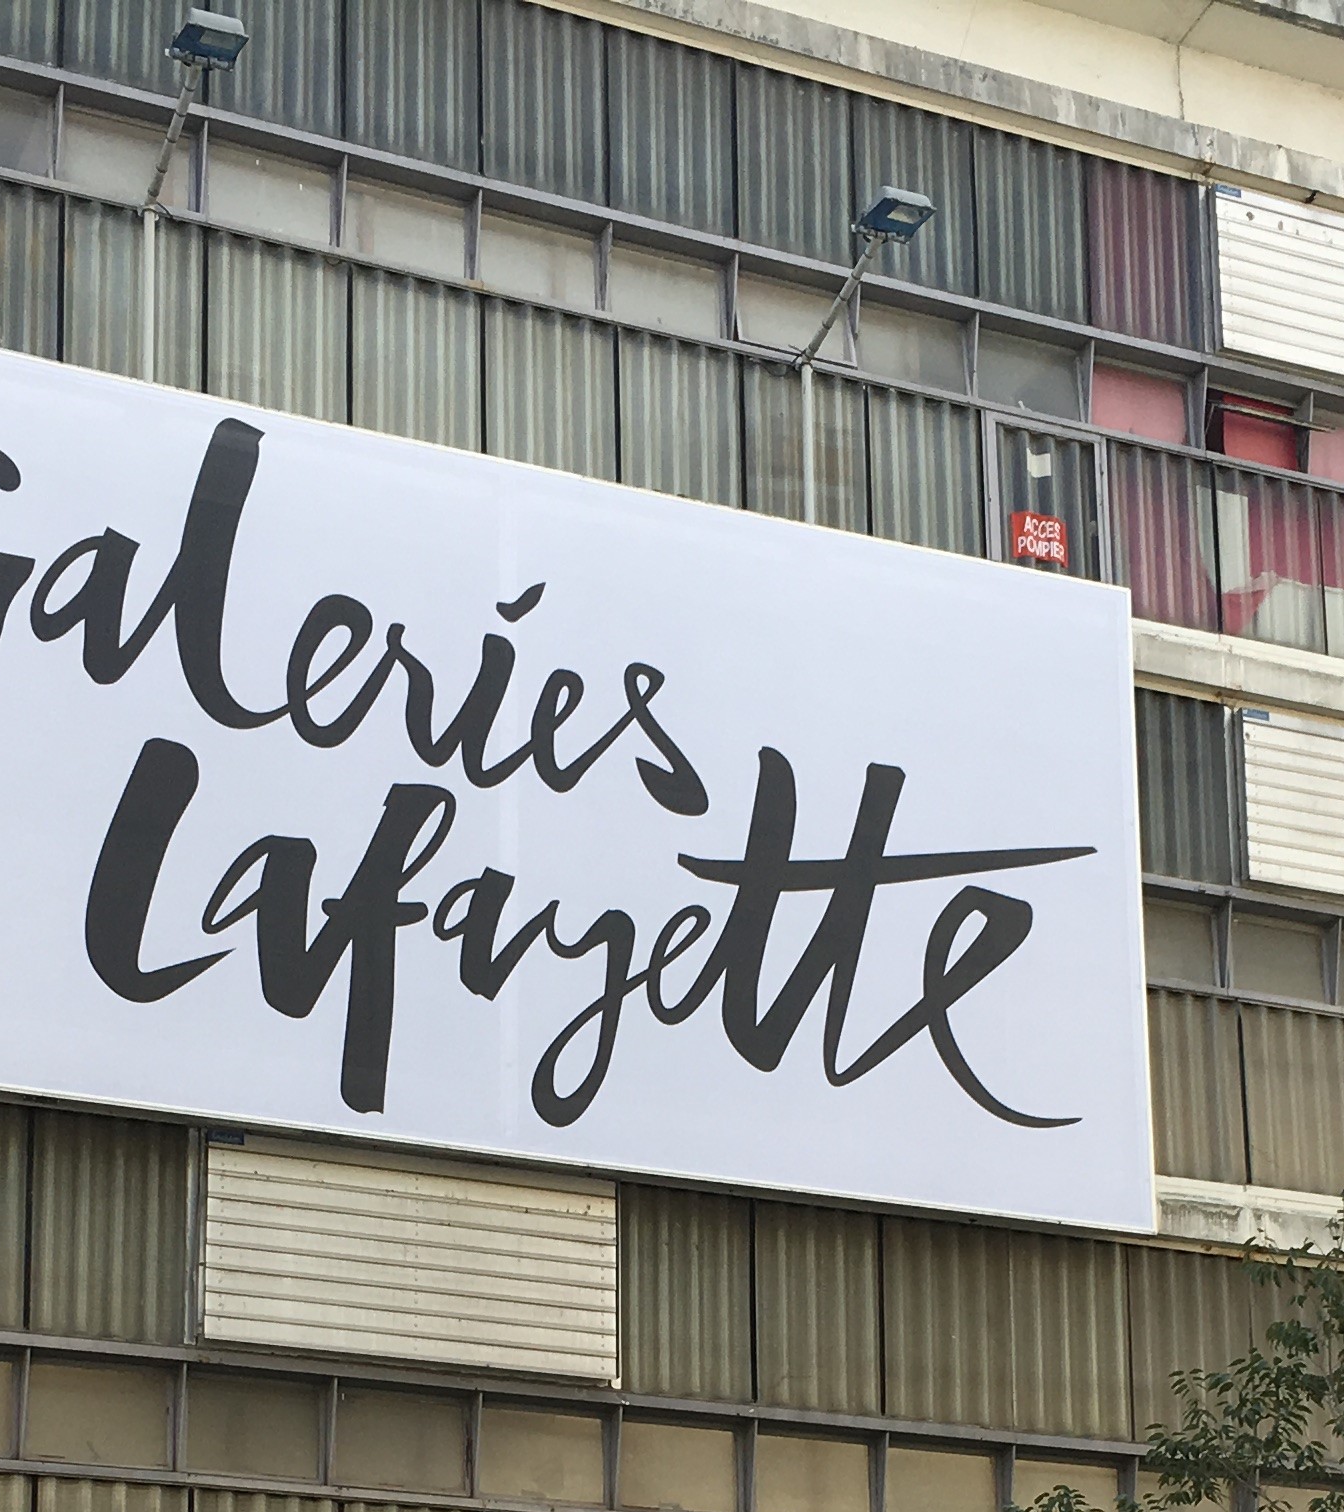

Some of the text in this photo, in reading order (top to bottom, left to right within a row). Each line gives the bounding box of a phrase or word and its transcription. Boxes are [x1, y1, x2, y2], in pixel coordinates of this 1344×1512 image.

[1023, 515, 1061, 540] ACCES
[1017, 535, 1065, 563] POMPIER
[84, 737, 1097, 1126] Lafayette
